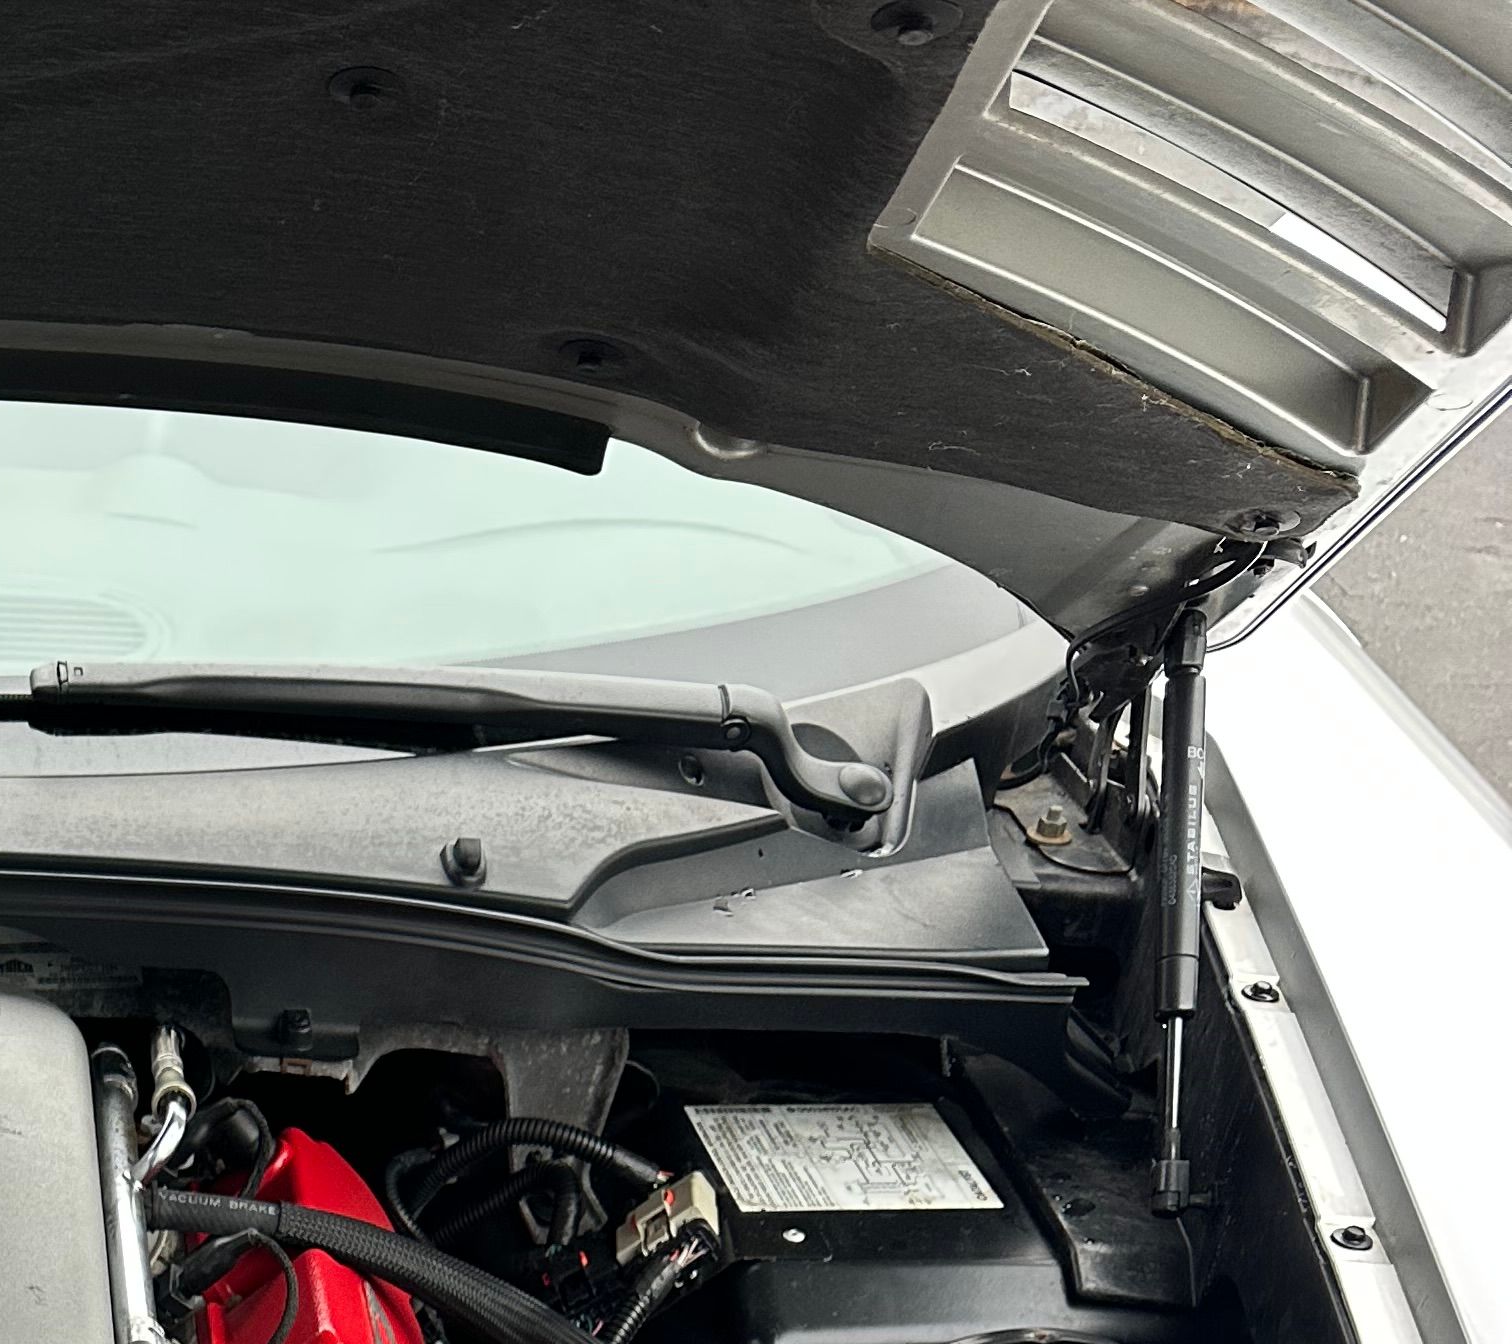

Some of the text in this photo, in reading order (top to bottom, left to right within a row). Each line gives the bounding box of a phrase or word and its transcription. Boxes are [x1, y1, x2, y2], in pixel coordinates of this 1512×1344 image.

[1187, 746, 1204, 759] BO
[157, 1190, 276, 1215] VACUUM BRAKE
